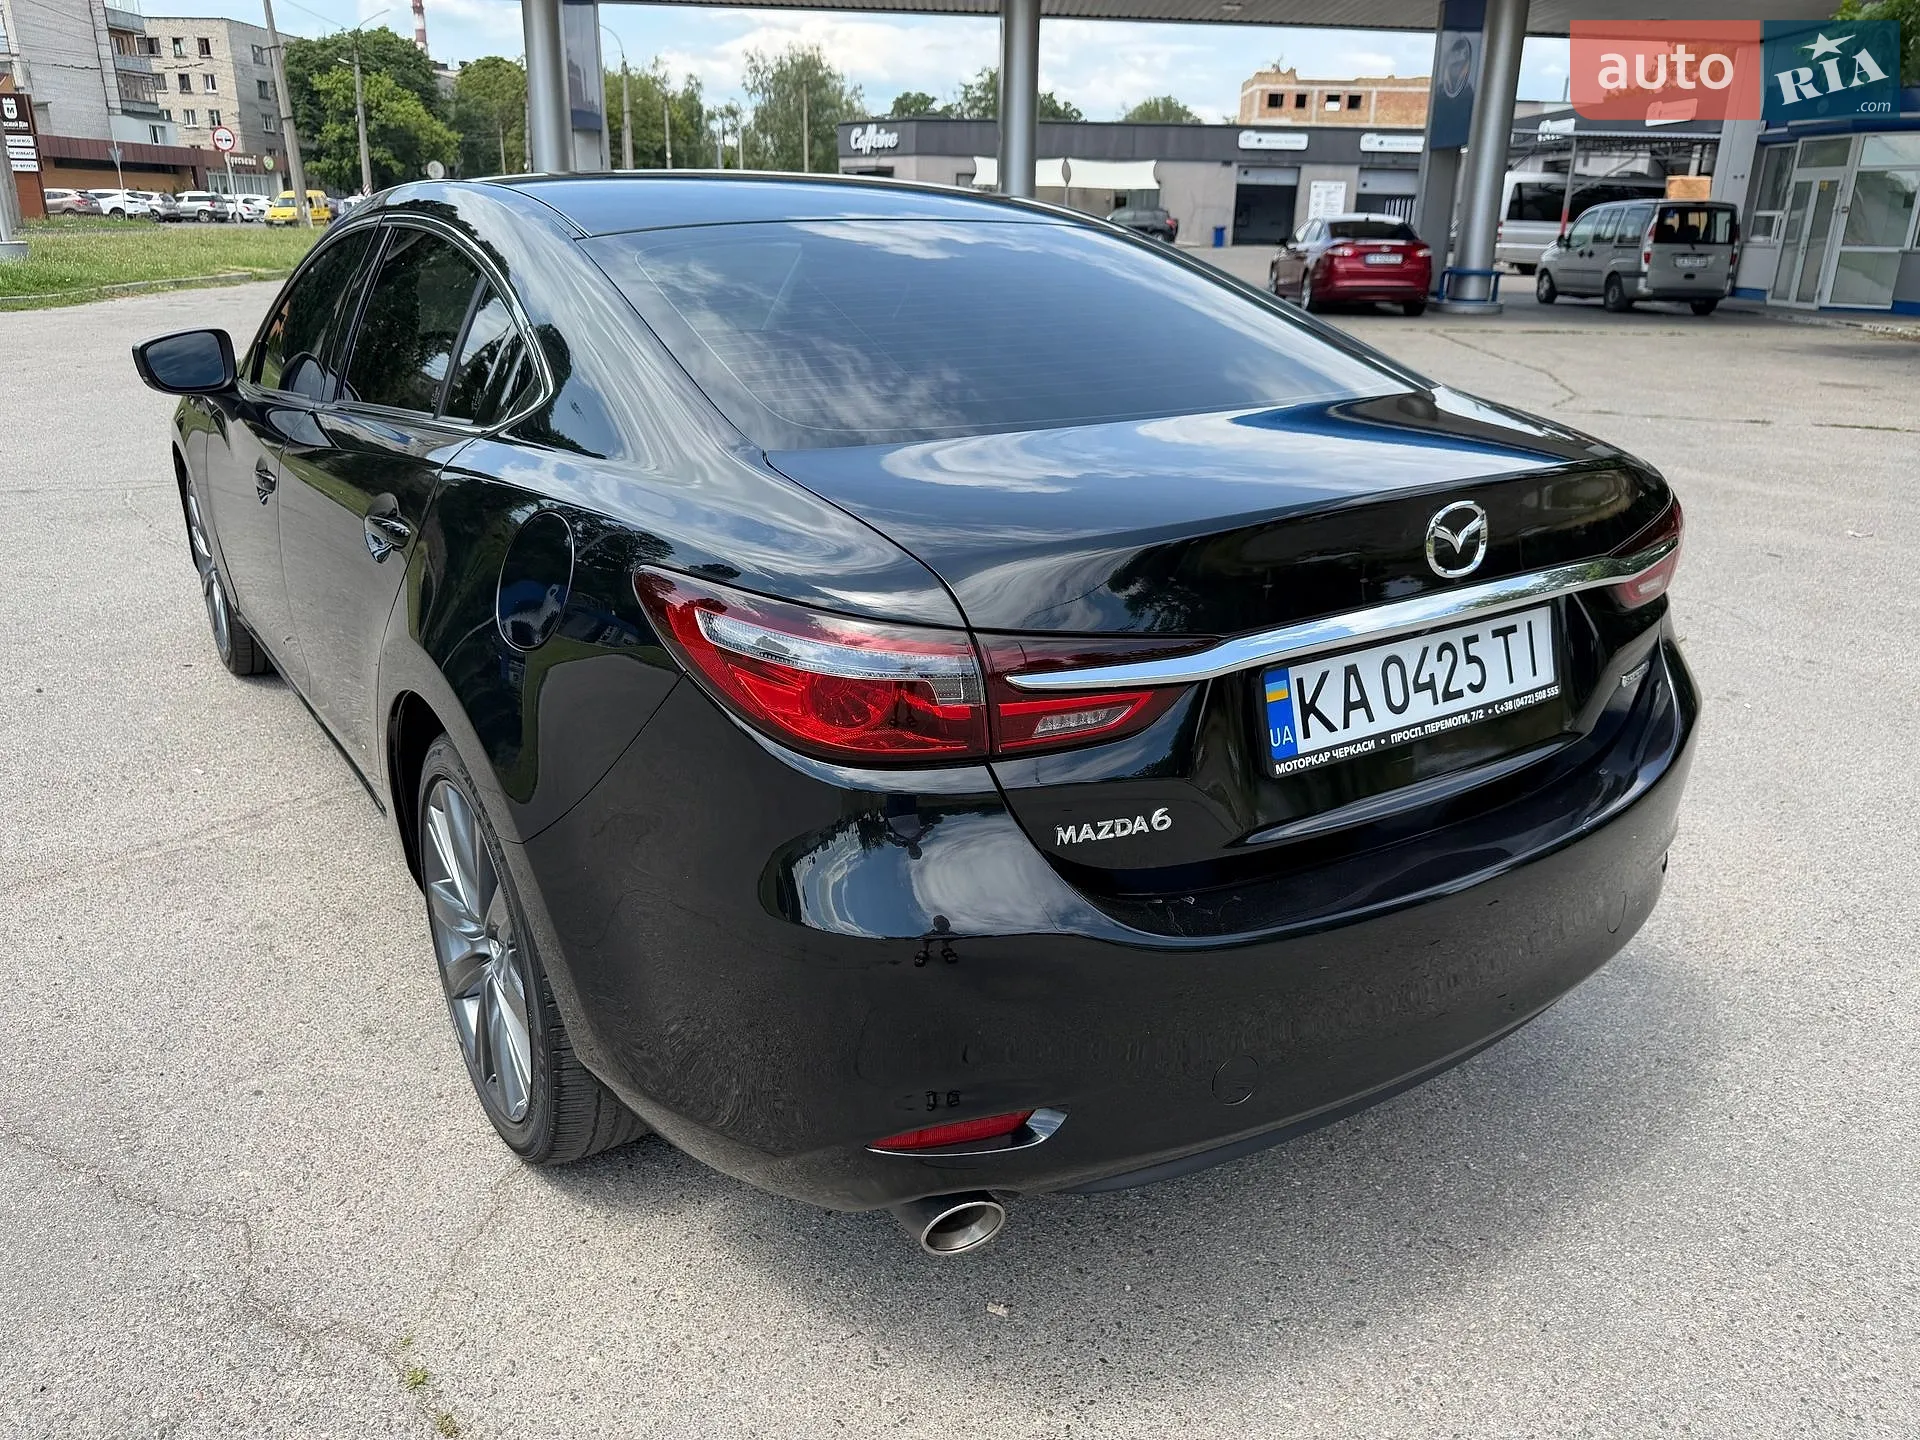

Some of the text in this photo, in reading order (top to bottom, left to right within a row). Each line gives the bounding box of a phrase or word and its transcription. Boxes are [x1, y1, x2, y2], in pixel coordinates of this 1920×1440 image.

[1296, 620, 1537, 739] KA 0425 TI
[1270, 726, 1294, 747] UA
[1275, 752, 1330, 775] МОТОРКАР
[1332, 740, 1376, 759] ЧЕРКАСИ
[1390, 727, 1425, 744] ПРОСП.
[1471, 709, 1485, 723] 7/2
[1513, 694, 1535, 709] (0472)
[1547, 685, 1559, 697] 555
